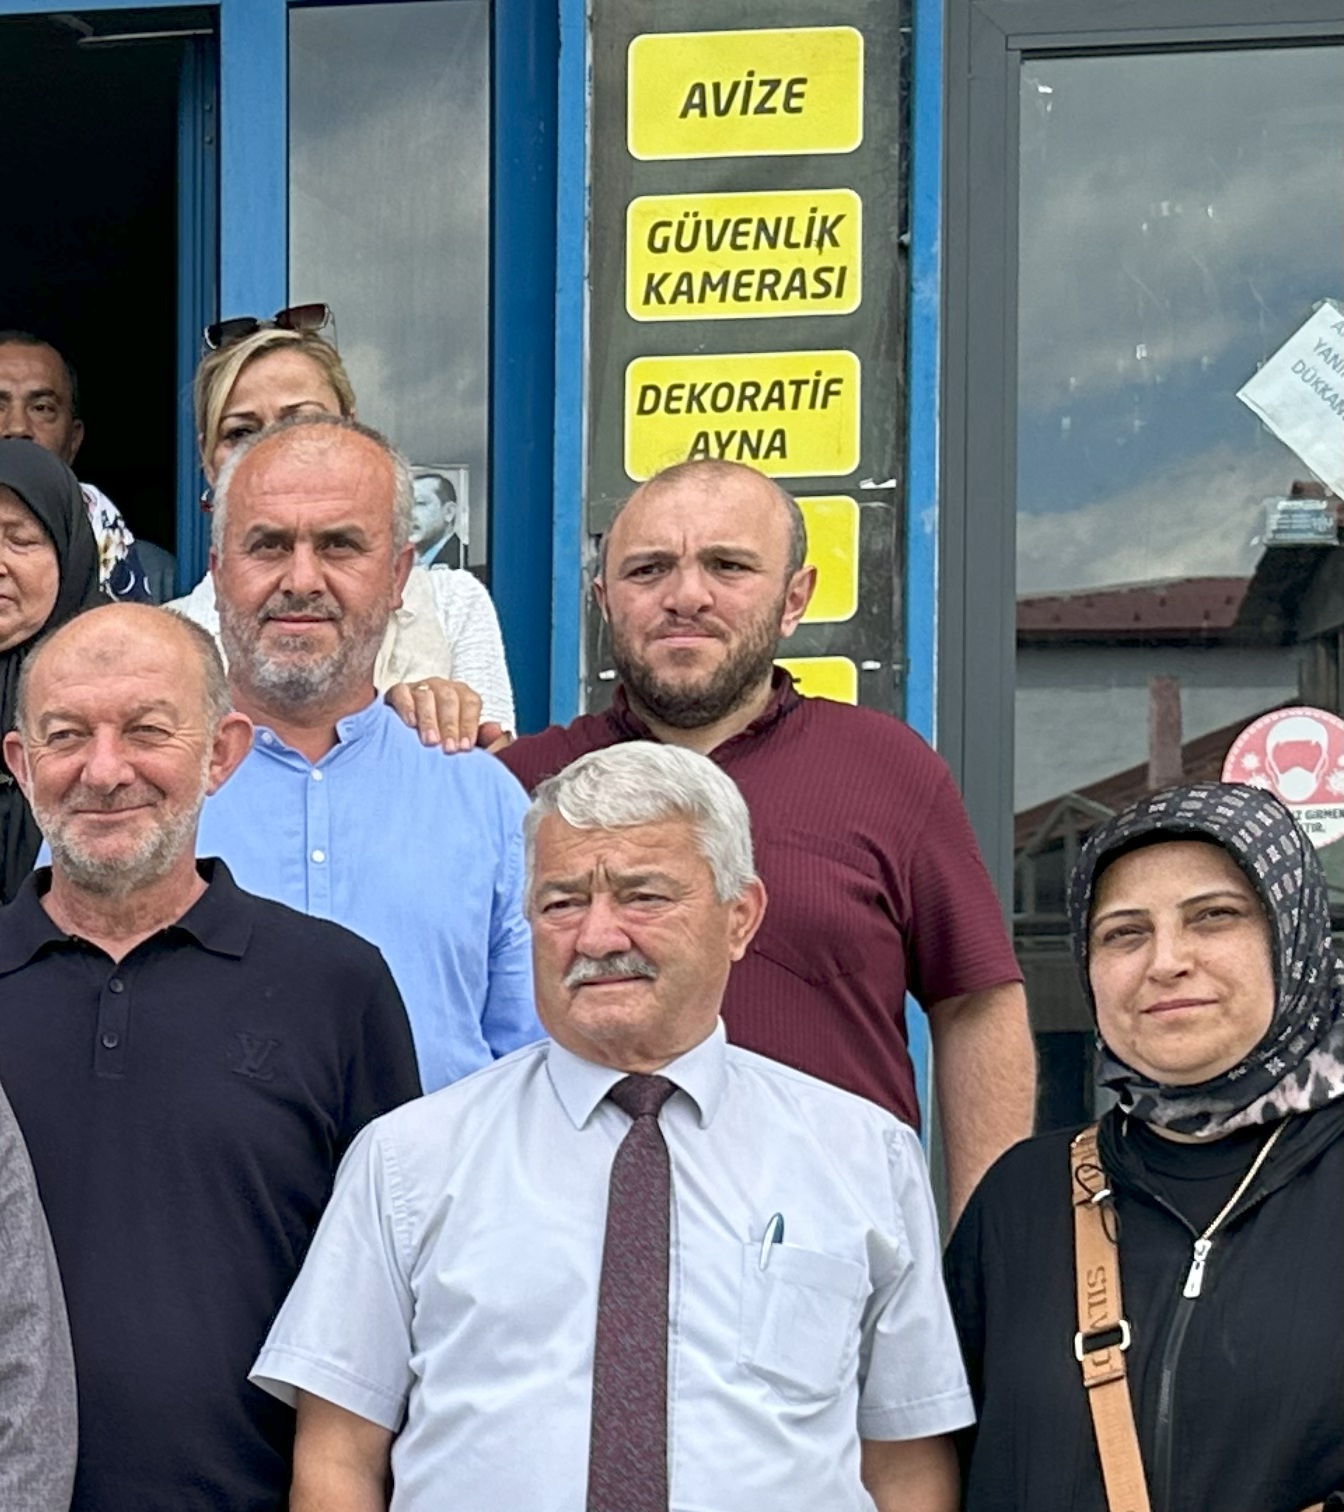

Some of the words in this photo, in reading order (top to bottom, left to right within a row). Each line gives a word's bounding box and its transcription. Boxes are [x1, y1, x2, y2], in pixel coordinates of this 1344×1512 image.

[678, 69, 808, 119] AVİZE
[646, 206, 847, 254] GÜVENLİK
[642, 266, 848, 306] KAMERASI
[636, 370, 844, 416] DEKORATİF
[1291, 358, 1344, 421] DÜKKAN
[687, 428, 788, 461] AYNA
